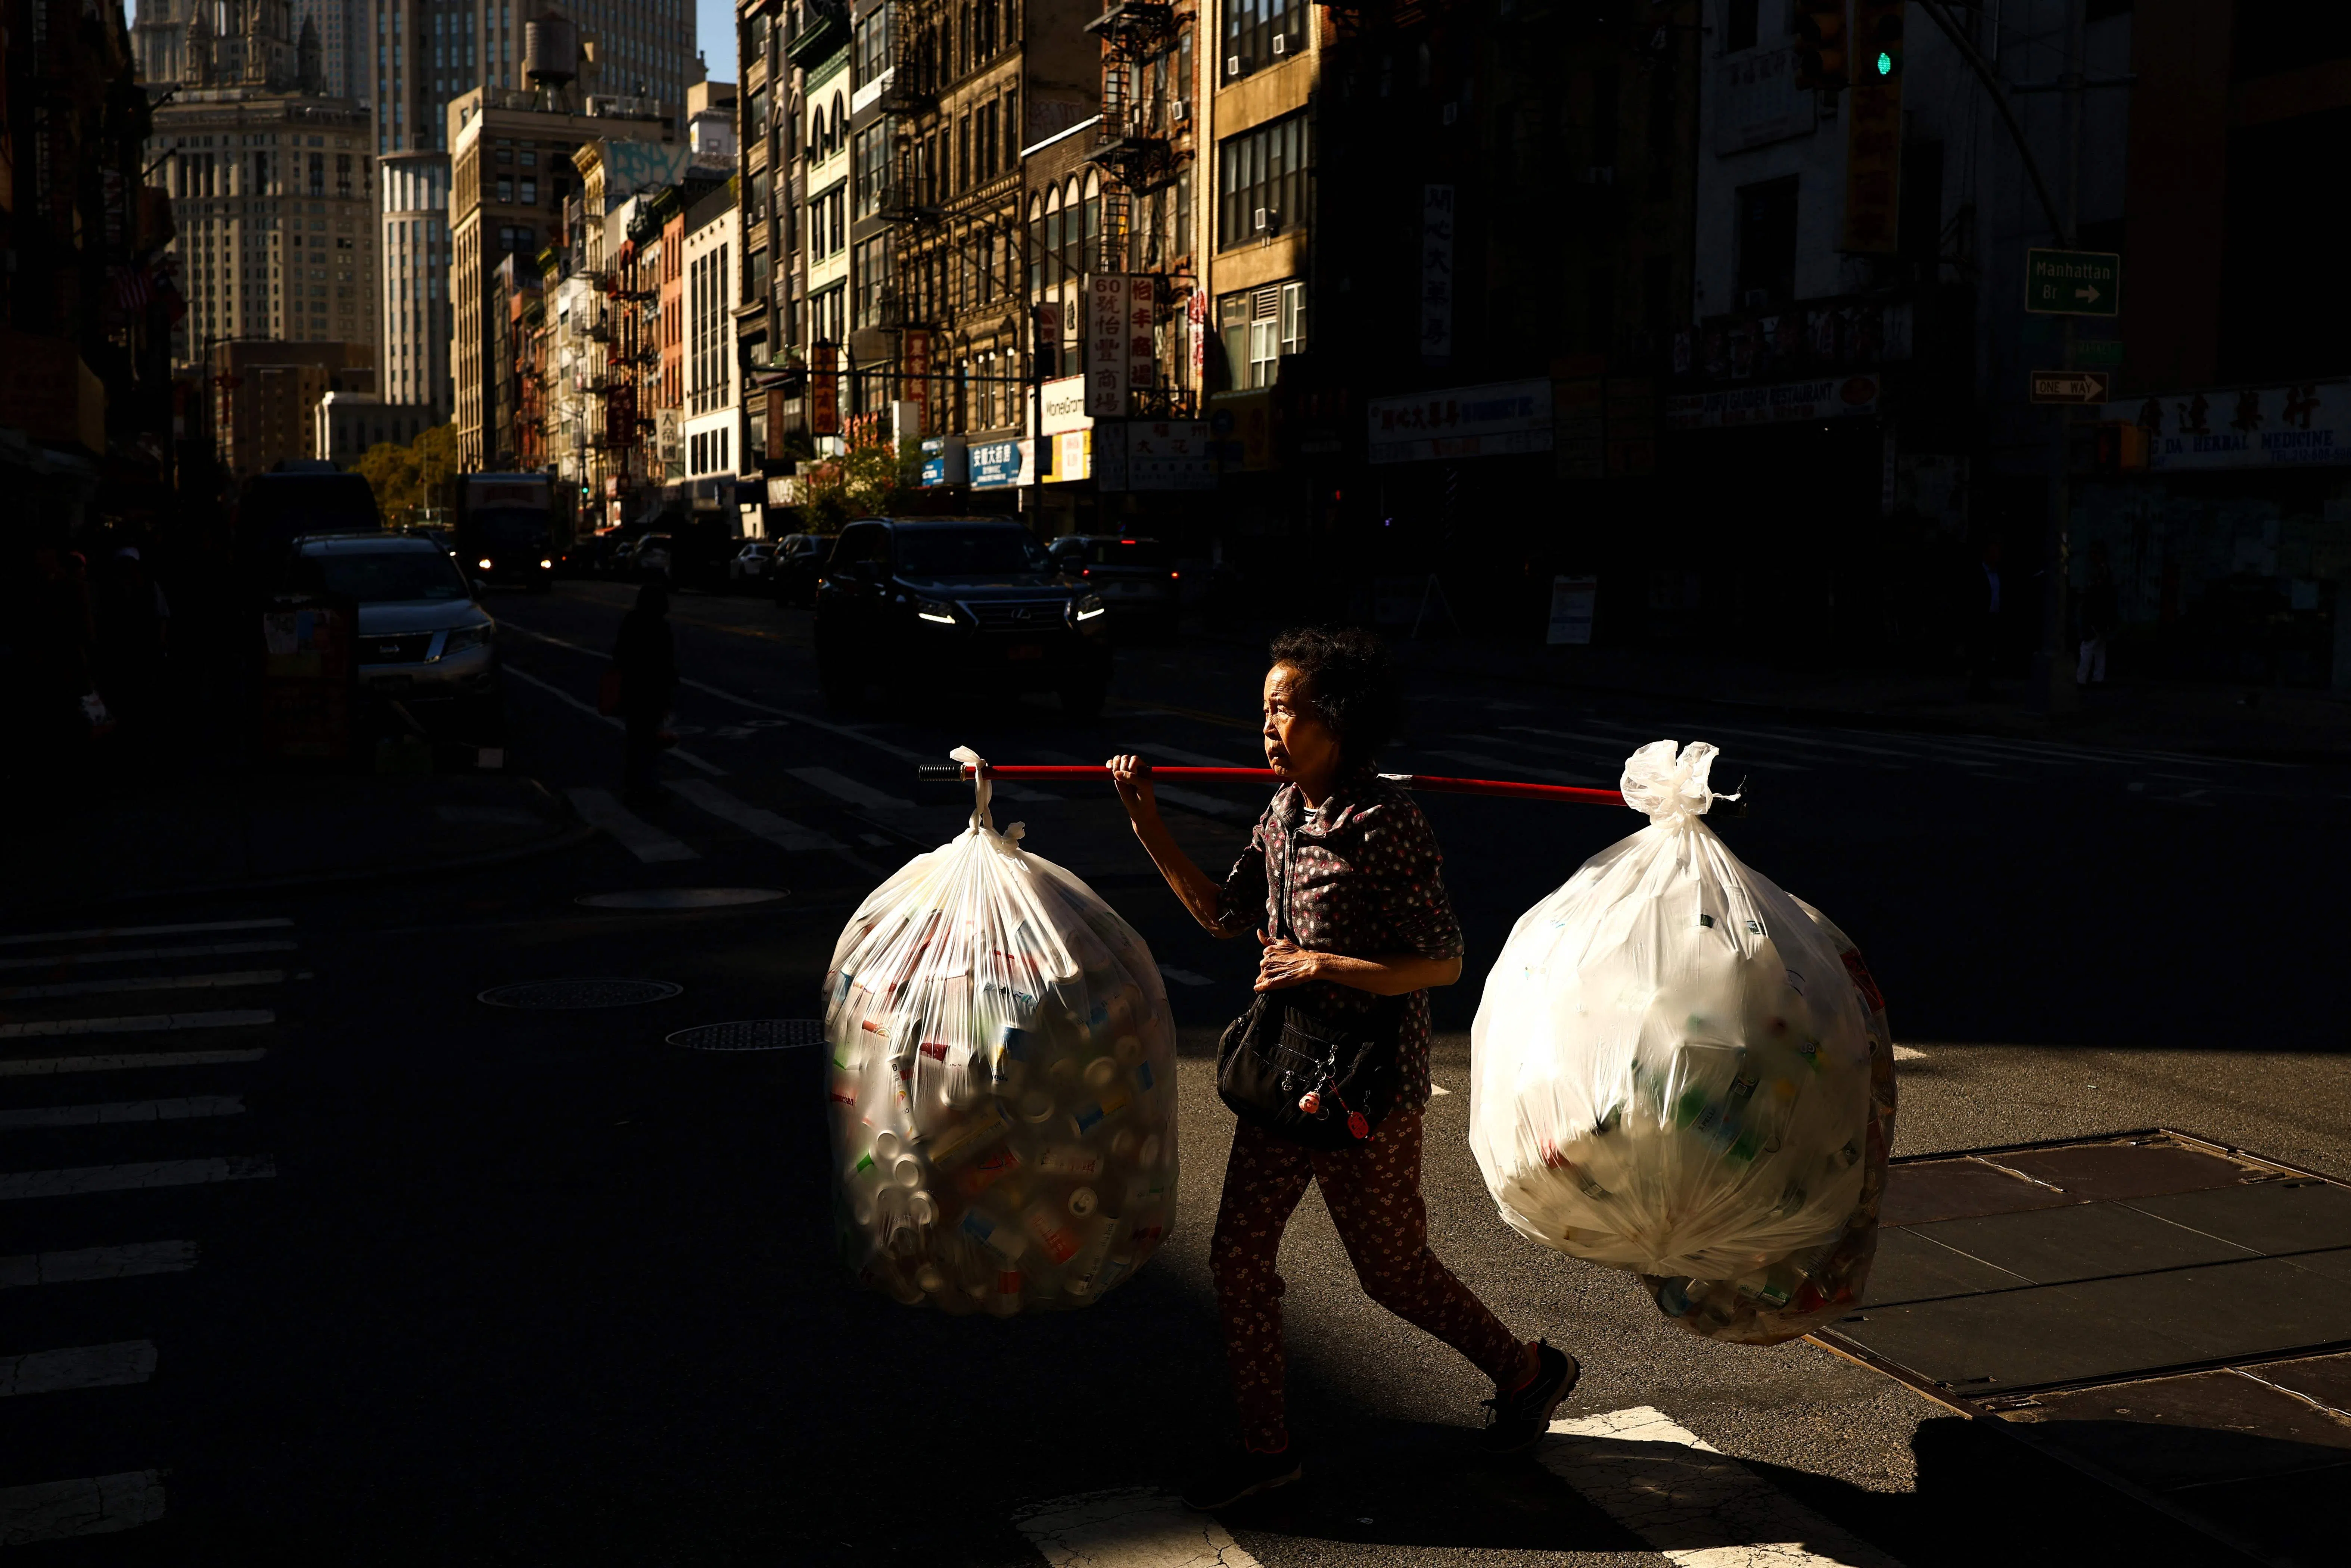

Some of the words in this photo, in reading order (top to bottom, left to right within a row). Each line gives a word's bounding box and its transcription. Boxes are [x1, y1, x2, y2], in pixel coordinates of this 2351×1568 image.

[2036, 261, 2110, 280] Manhattan
[2043, 283, 2058, 299] Br
[1770, 383, 1834, 405] RESTAURANT
[2039, 381, 2060, 394] ONE
[2071, 381, 2093, 394] WAY
[2165, 438, 2183, 454] DA
[2193, 435, 2249, 452] HERBAL
[2261, 430, 2333, 449] MEDICINE
